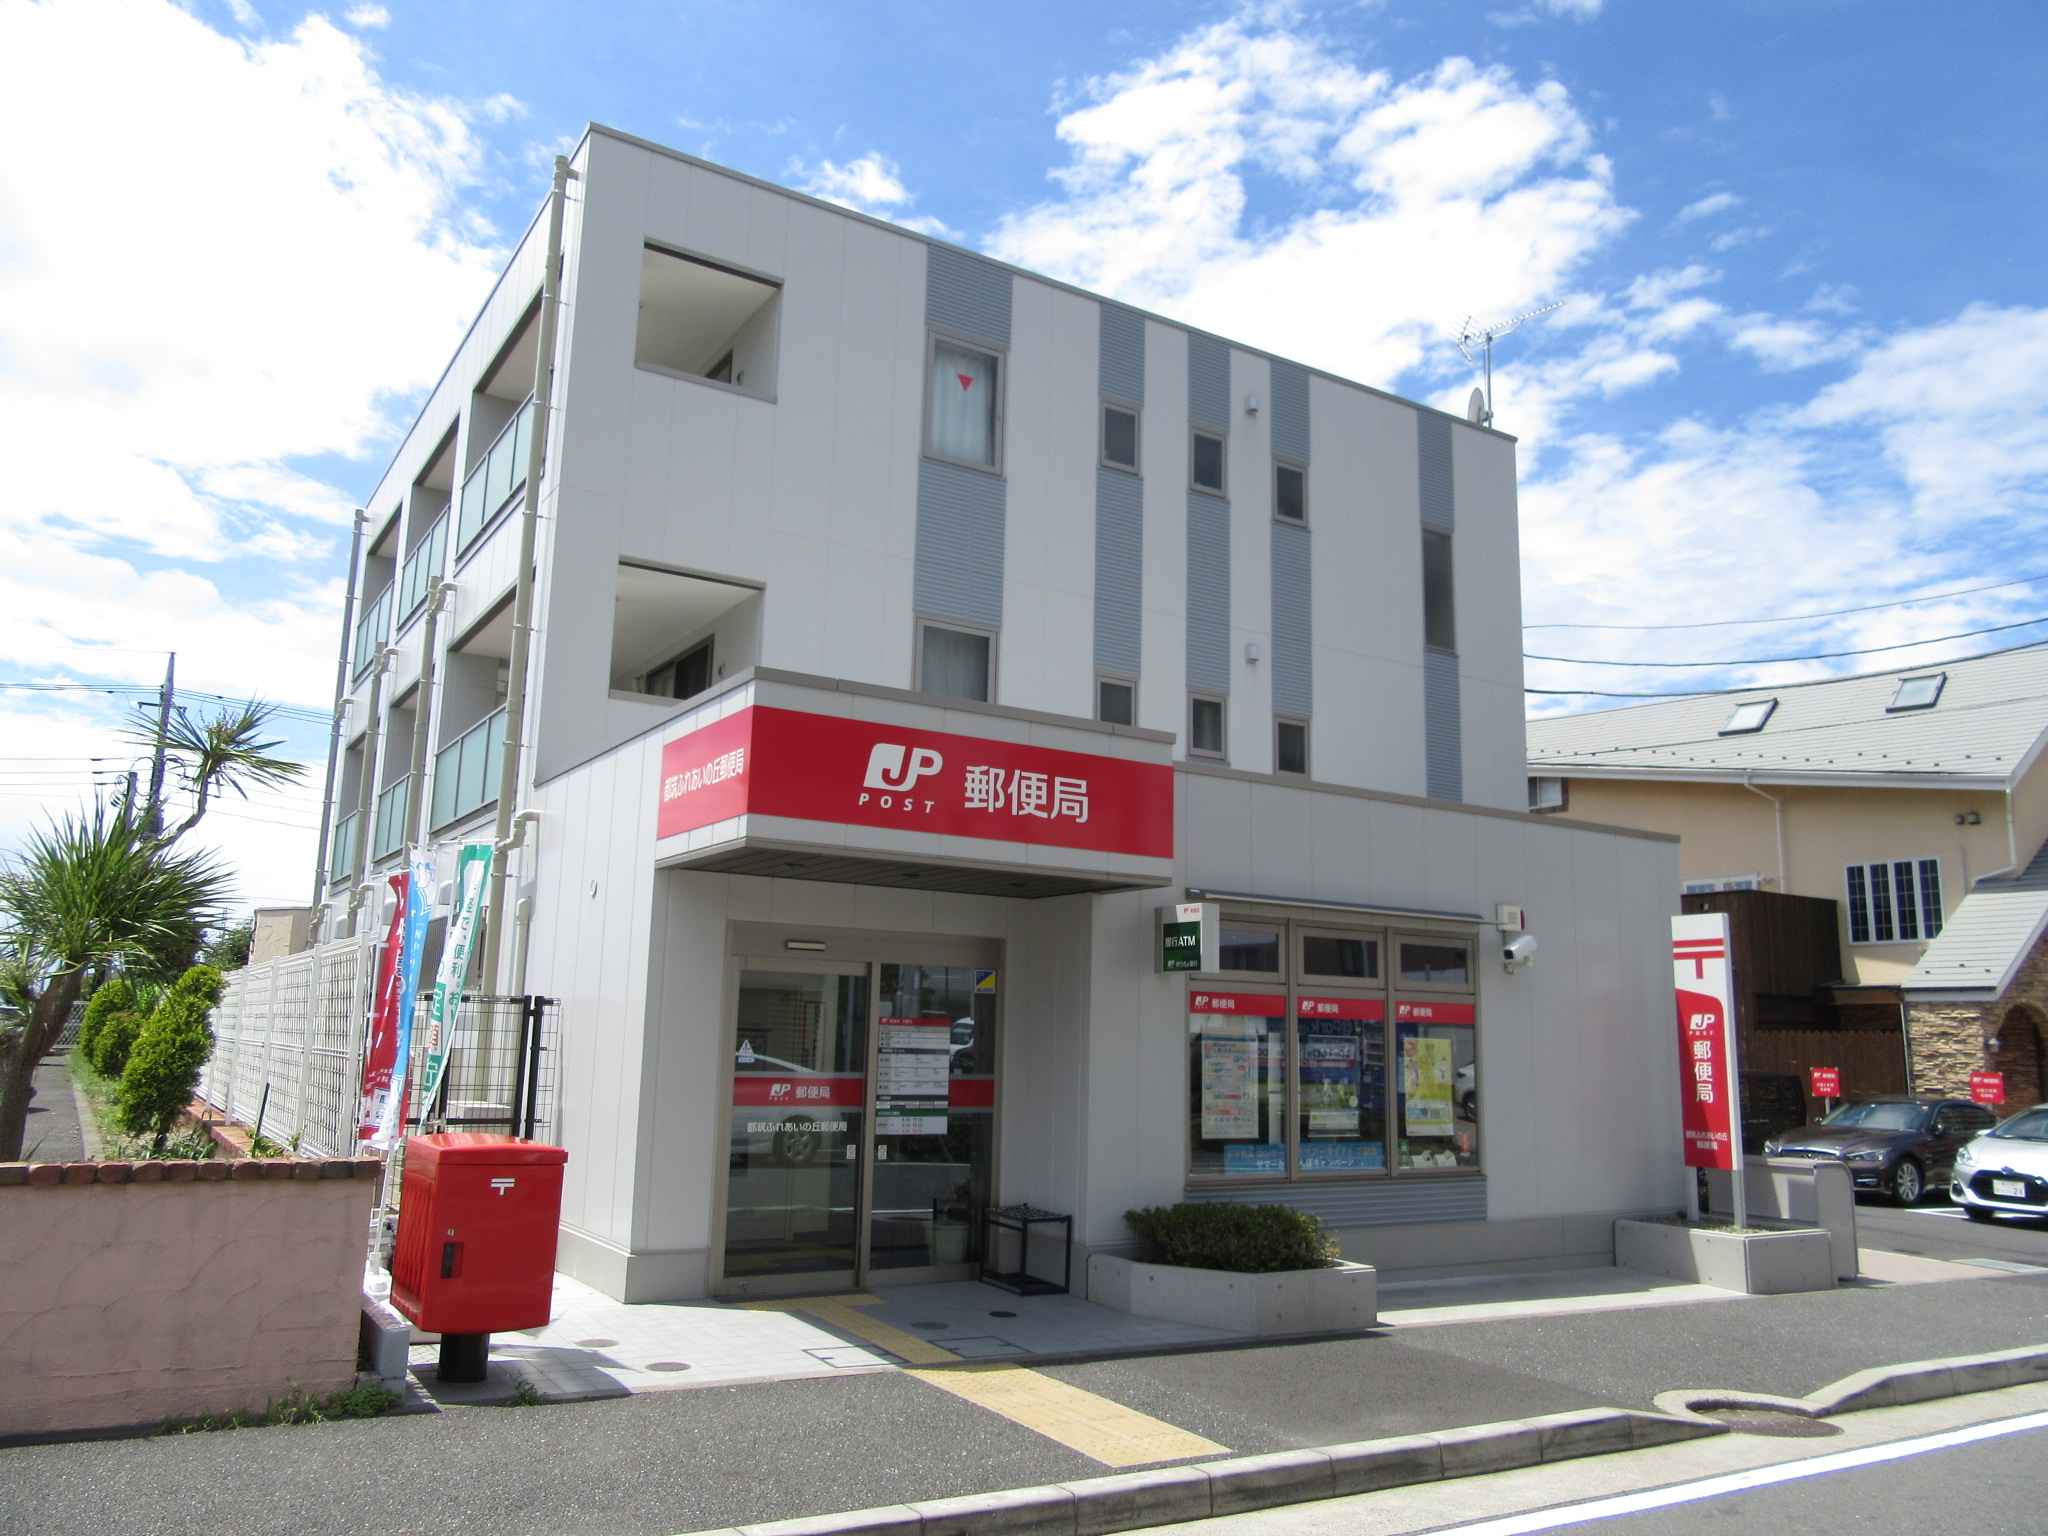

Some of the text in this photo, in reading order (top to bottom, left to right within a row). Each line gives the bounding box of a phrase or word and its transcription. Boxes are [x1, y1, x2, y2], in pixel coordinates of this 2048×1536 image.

[663, 748, 745, 803] 都筑ふれあいの丘郵便局
[964, 765, 1090, 823] 郵便局
[858, 793, 936, 814] POST
[1164, 935, 1196, 948] 銀行ATM
[1211, 998, 1236, 1010] 郵便局
[1317, 1003, 1339, 1014] 郵便局
[1412, 1008, 1433, 1018] 郵便局
[1693, 1040, 1714, 1104] 郵便局
[796, 1086, 831, 1099] 郵便局
[747, 1121, 848, 1133] 都筑ふれあいの丘郵便局
